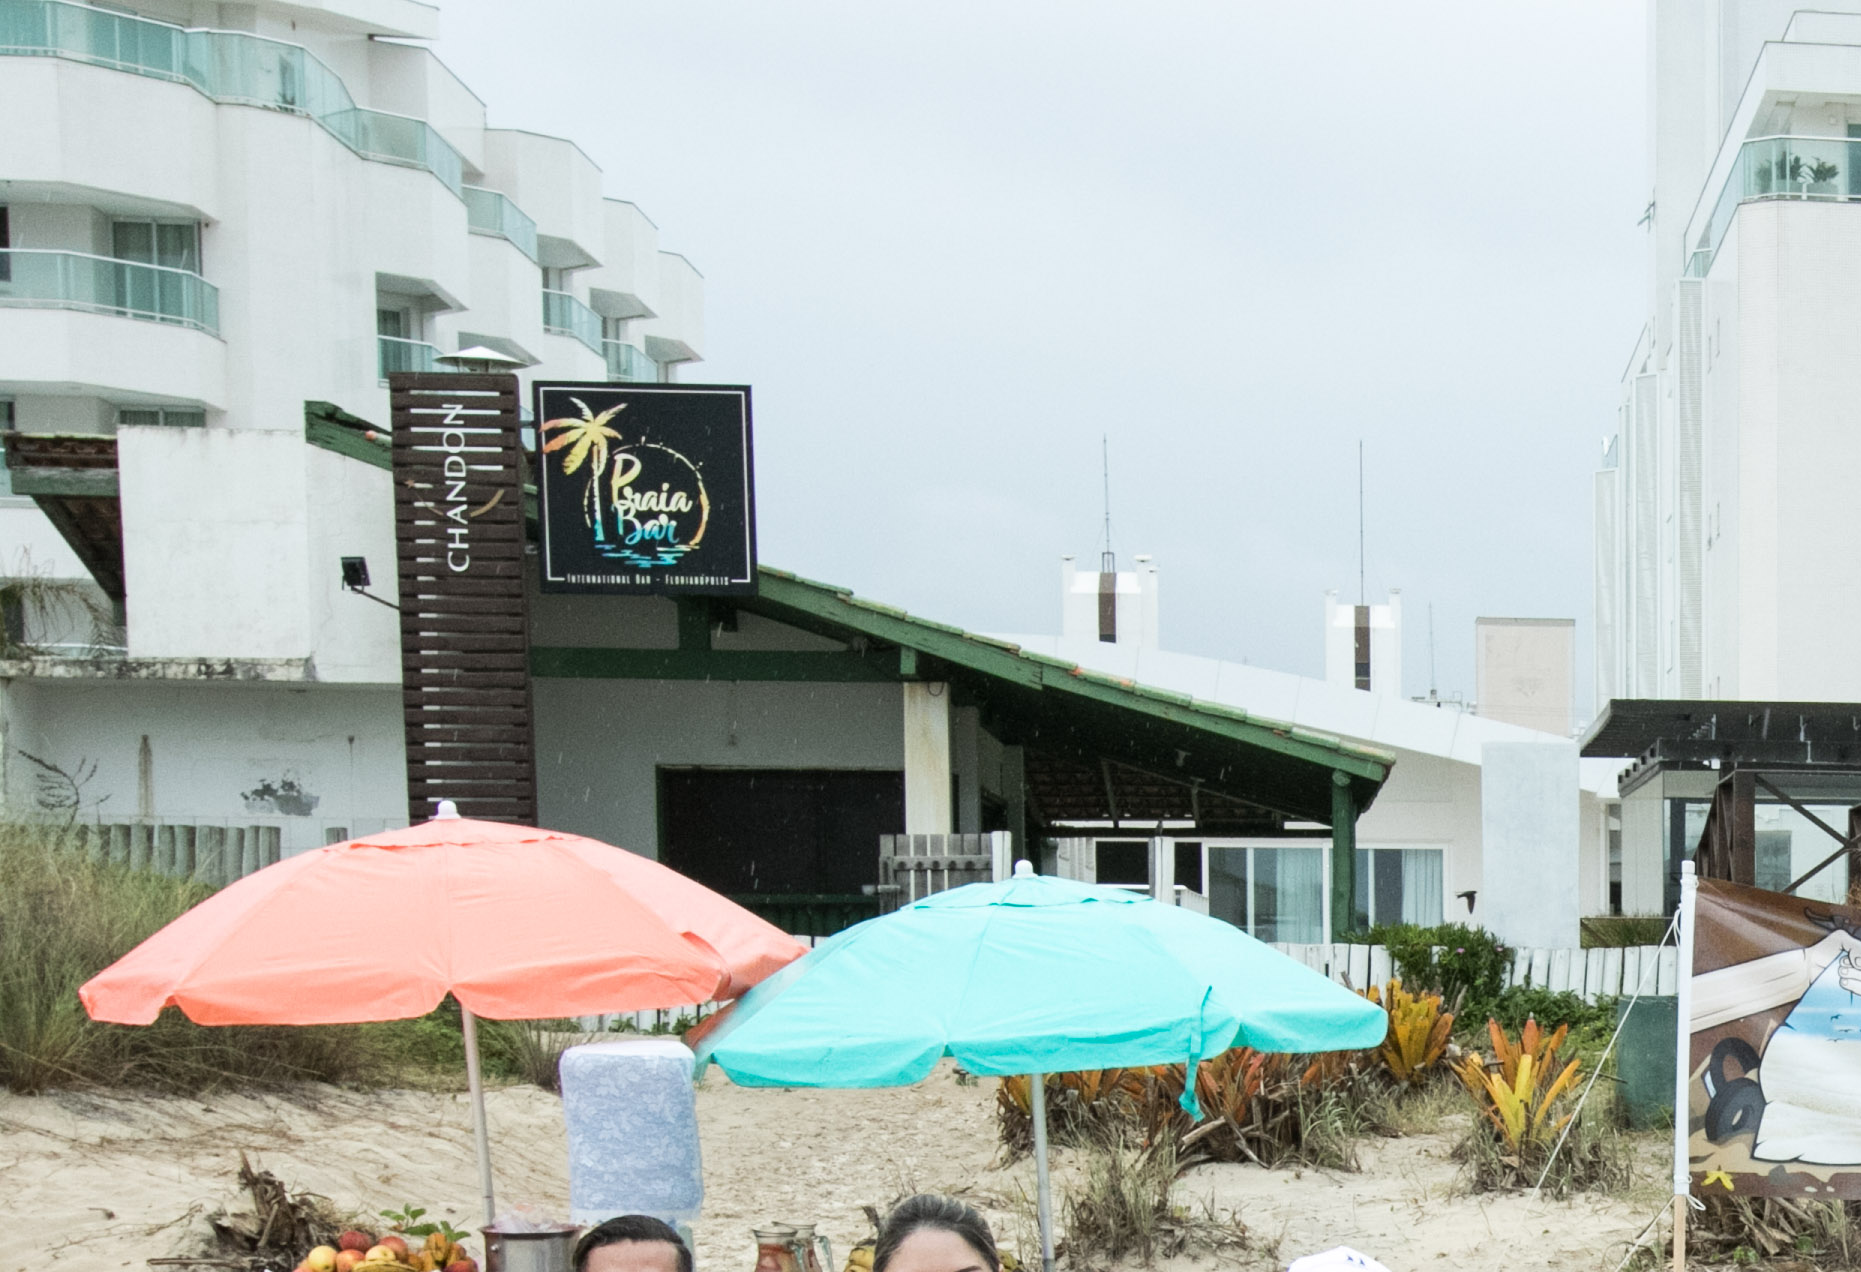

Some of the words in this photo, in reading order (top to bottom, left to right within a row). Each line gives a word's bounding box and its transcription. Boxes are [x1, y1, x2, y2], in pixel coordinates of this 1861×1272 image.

[442, 403, 471, 573] CHANDON
[610, 453, 694, 512] Praia
[611, 500, 680, 545] Bar
